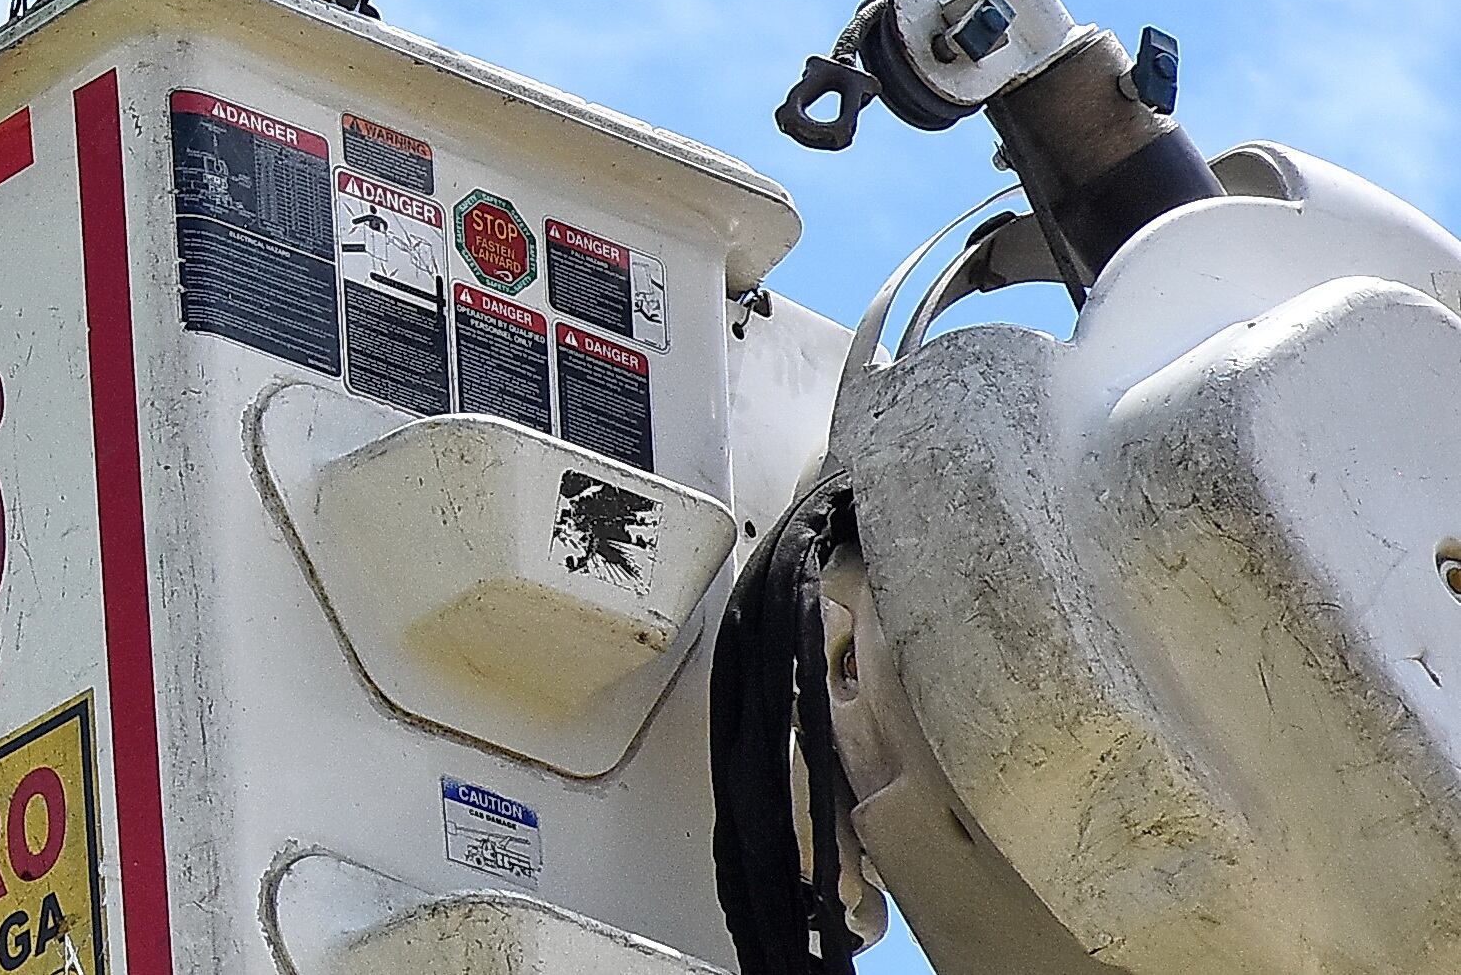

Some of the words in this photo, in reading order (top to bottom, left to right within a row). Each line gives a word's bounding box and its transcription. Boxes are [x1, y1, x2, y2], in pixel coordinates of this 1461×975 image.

[226, 105, 298, 146] DANGER
[365, 123, 427, 156] WARNING
[362, 183, 435, 224] DANGER
[472, 209, 518, 243] STOP
[471, 245, 521, 274] LANYARD
[475, 236, 515, 259] FASTEN
[566, 230, 619, 262] DANGER
[456, 304, 496, 325] OPERATION
[508, 324, 546, 344] QUALIFIED
[482, 296, 532, 327] DANGER
[584, 337, 639, 370] DANGER
[459, 786, 523, 820] CAUTION
